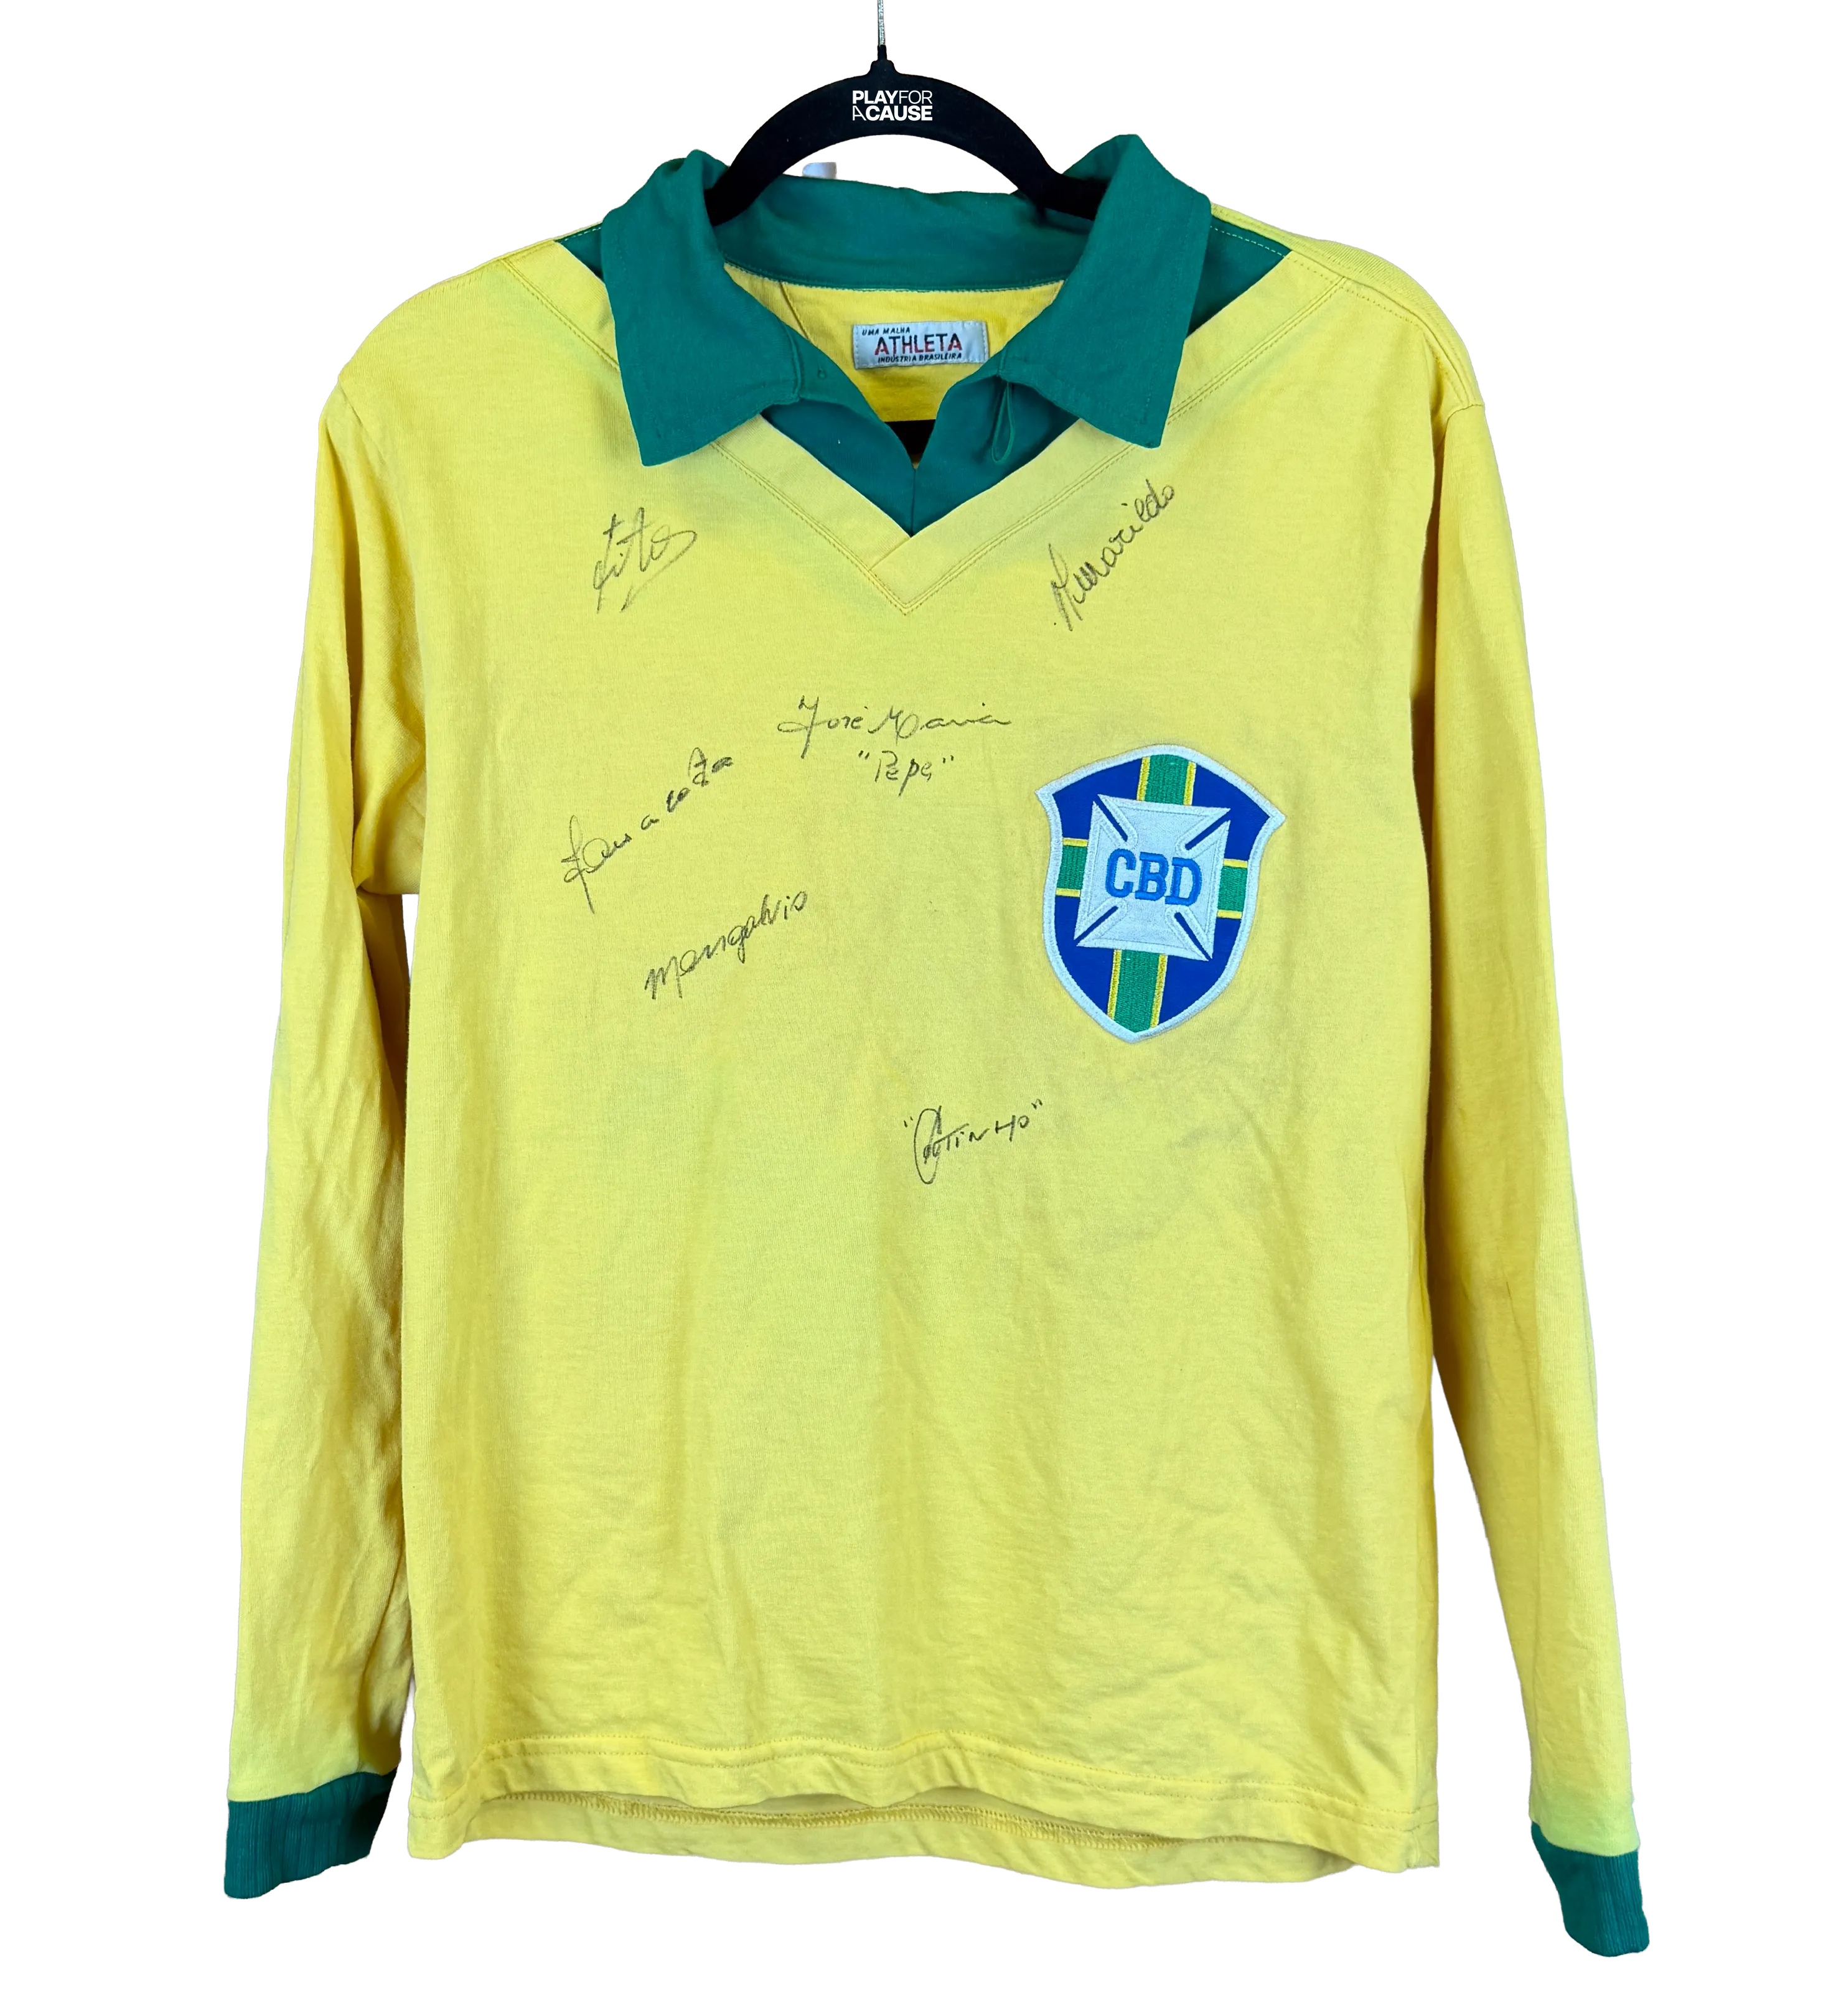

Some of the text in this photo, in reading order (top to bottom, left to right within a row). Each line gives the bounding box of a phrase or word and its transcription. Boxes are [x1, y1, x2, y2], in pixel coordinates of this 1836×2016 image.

[874, 333, 962, 355] ATHLETA
[919, 353, 962, 361] BRASILEIRA
[1105, 848, 1203, 907] CBD
